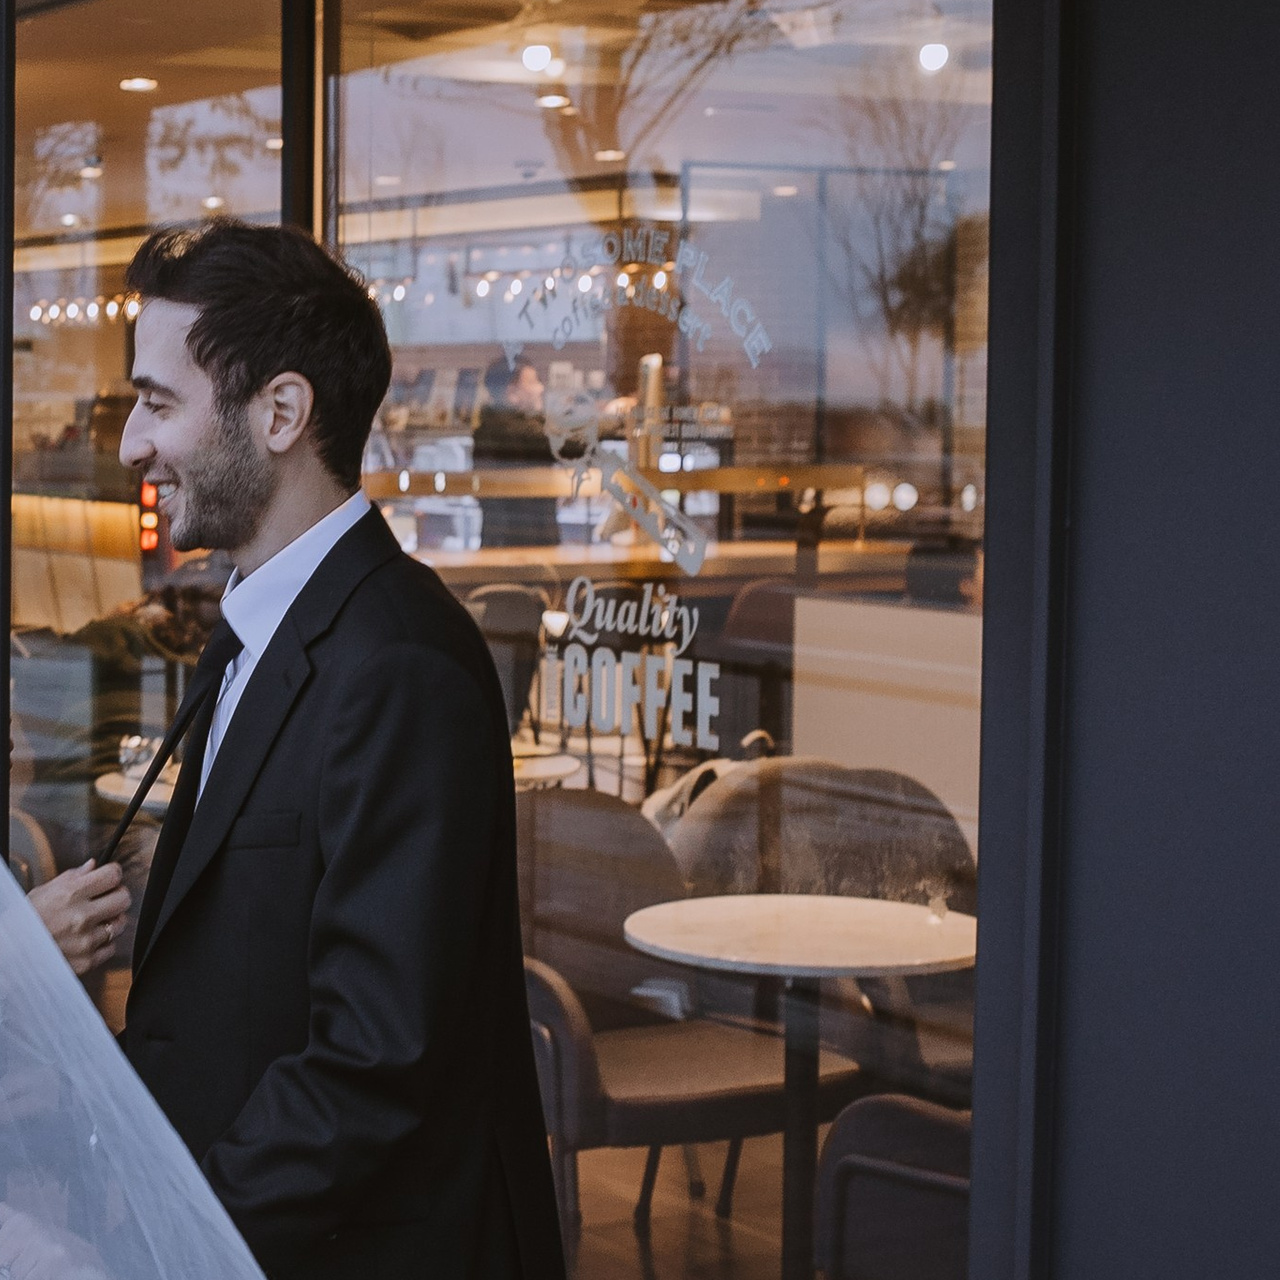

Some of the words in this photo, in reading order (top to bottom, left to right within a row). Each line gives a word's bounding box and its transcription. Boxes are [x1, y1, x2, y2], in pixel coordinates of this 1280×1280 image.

[519, 228, 671, 329] TWOSOME
[674, 238, 772, 370] PLACE
[632, 274, 712, 353] dessert
[566, 576, 699, 657] Quality
[564, 643, 720, 752] COFFEE
